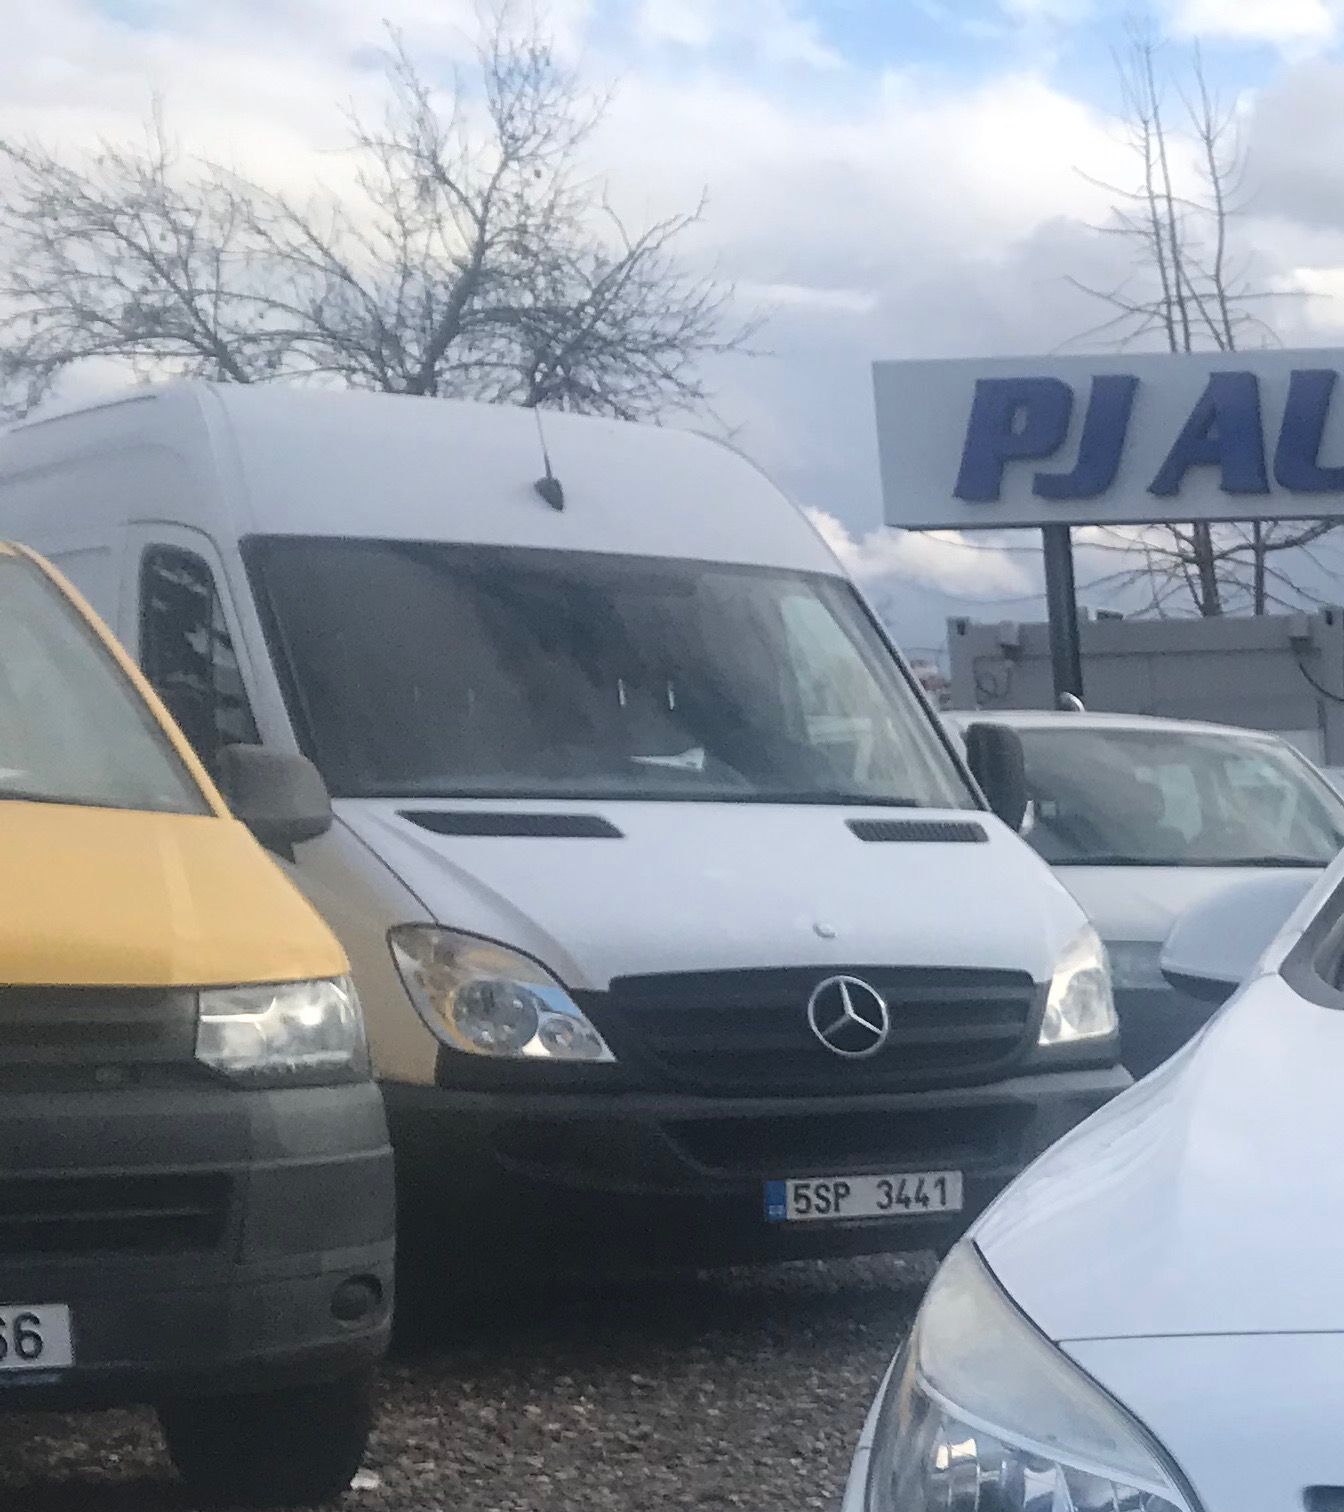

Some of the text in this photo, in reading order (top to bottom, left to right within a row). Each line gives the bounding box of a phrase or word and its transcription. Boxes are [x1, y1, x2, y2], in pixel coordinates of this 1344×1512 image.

[953, 373, 1140, 501] PJ
[793, 1175, 947, 1214] 5SP 3441
[0, 1312, 43, 1361] 6
